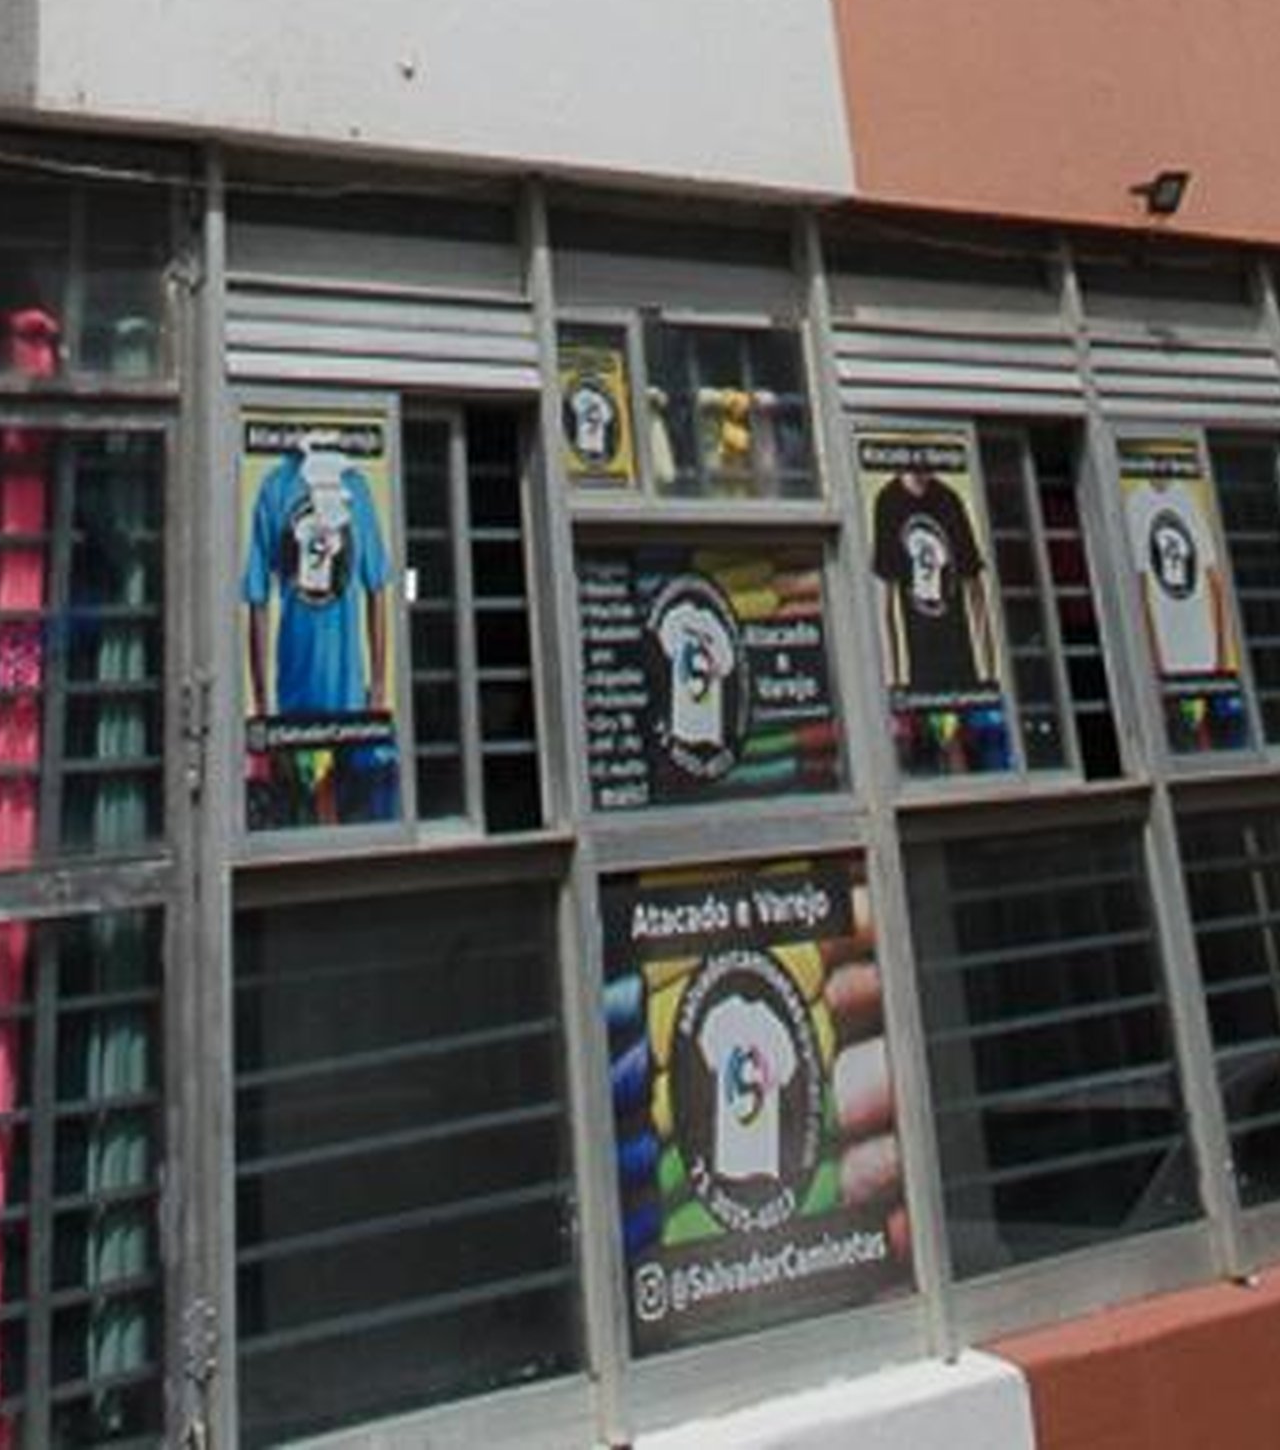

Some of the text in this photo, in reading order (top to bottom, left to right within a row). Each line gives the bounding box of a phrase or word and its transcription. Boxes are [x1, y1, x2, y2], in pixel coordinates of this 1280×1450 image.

[631, 883, 830, 941] Atacado e Varejo
